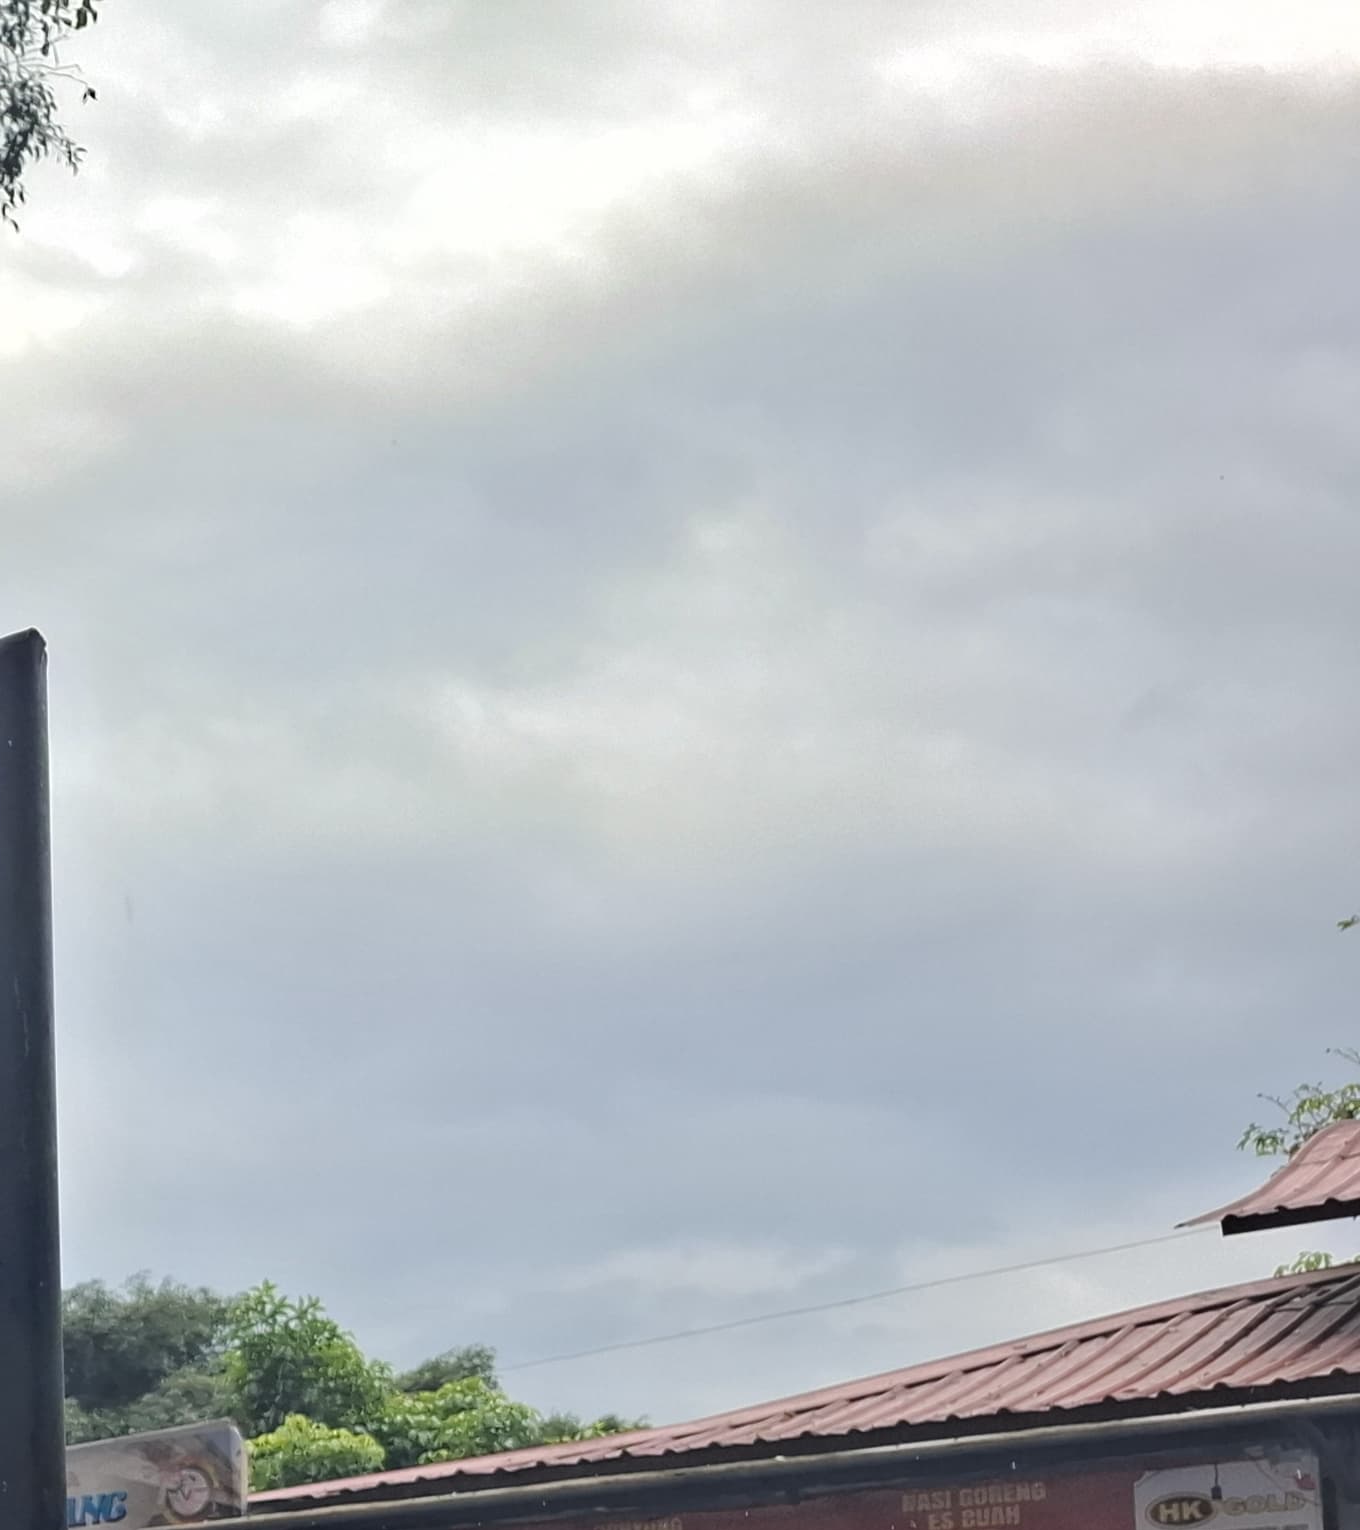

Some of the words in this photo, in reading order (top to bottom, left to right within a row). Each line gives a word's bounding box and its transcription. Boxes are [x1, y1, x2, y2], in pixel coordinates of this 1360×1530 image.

[902, 1488, 951, 1512] NASI
[958, 1481, 1047, 1508] GORENG
[1158, 1500, 1203, 1523] HK
